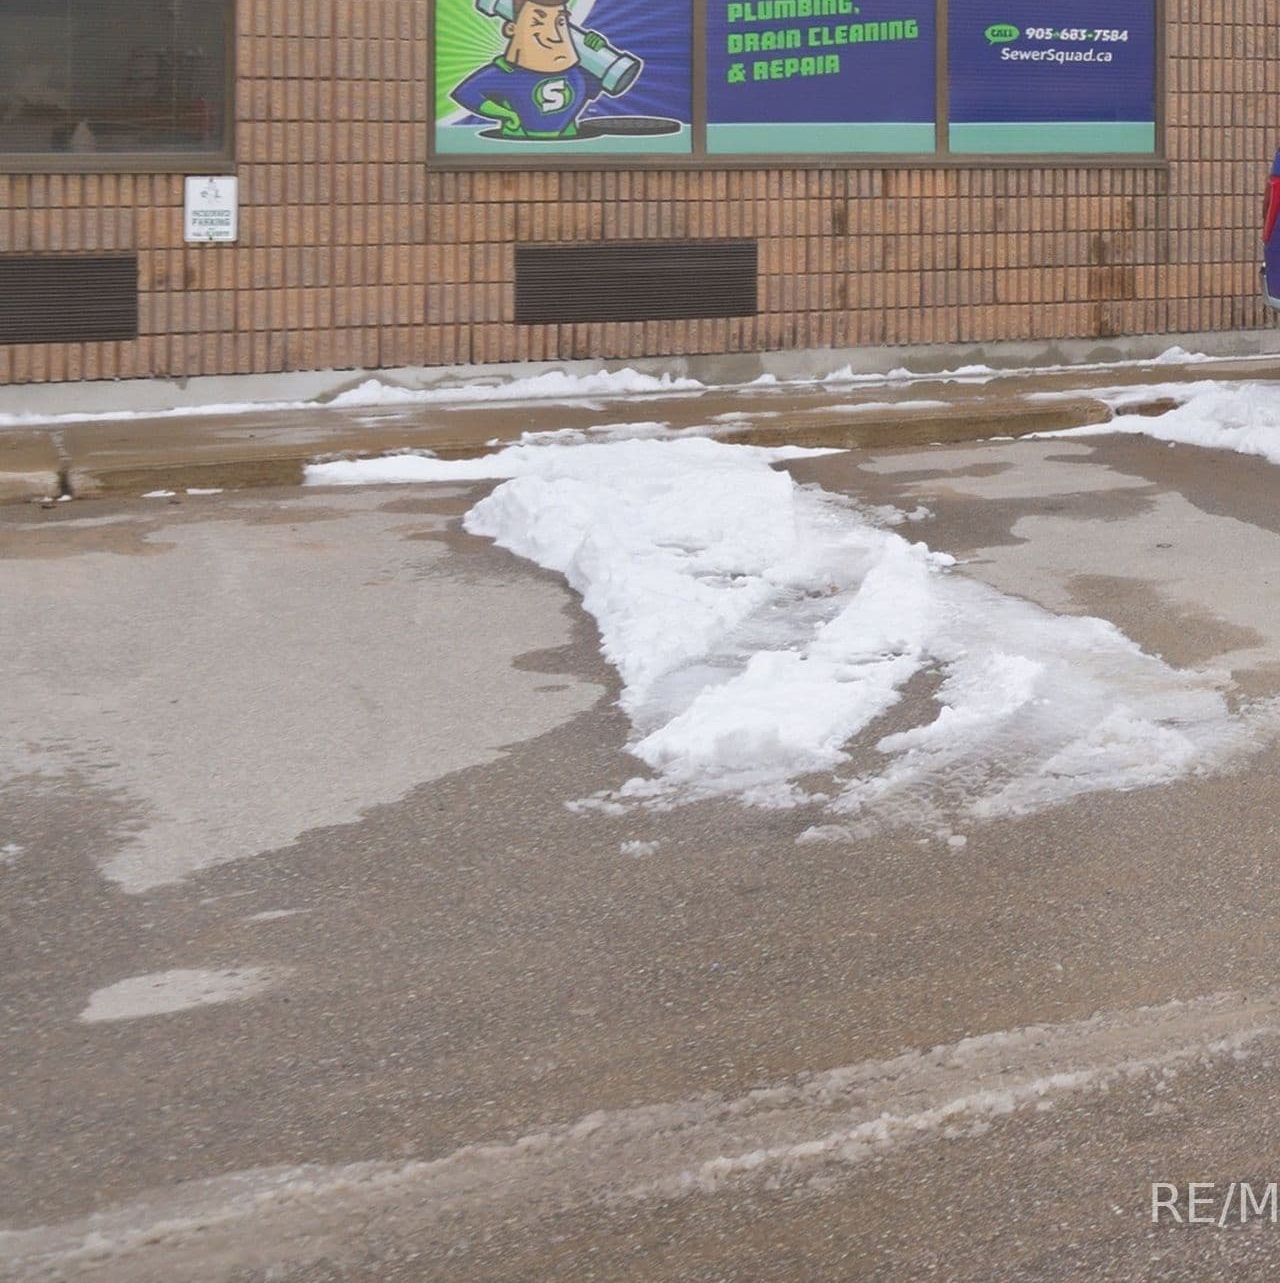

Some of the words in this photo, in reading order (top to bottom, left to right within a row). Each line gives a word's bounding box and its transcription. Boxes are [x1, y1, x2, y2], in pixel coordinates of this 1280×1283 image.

[727, 28, 801, 54] DRAIN
[808, 19, 919, 46] CLEANING
[1025, 27, 1129, 42] 905-683-7584
[727, 62, 746, 83] &
[753, 54, 840, 80] REPAIR
[1001, 47, 1113, 64] SewerSquad.ca
[543, 79, 565, 112] S
